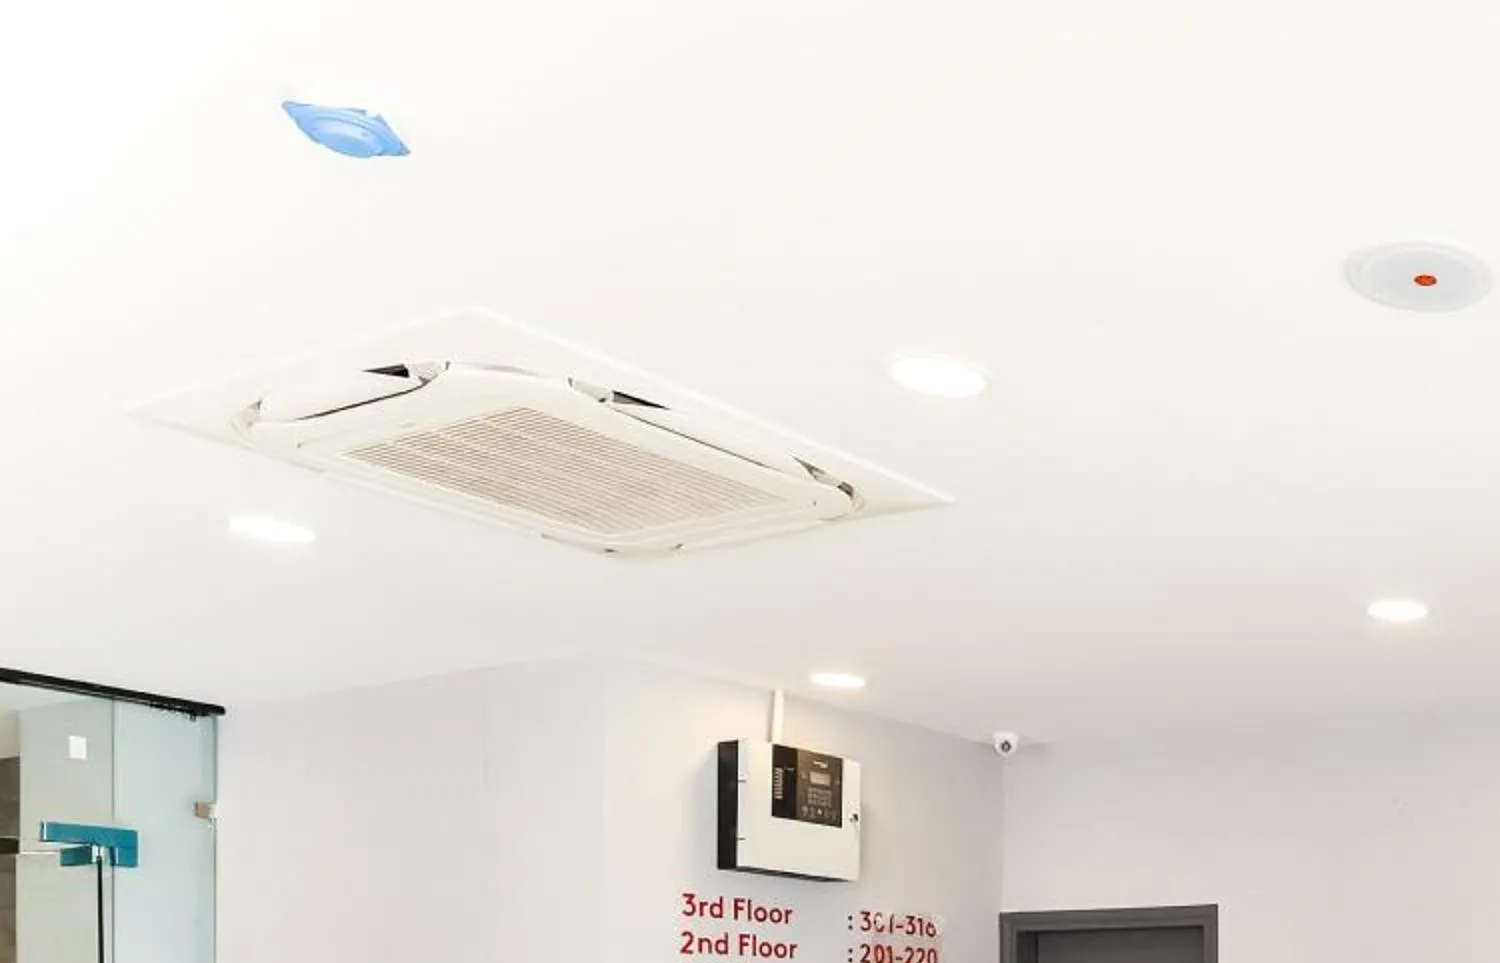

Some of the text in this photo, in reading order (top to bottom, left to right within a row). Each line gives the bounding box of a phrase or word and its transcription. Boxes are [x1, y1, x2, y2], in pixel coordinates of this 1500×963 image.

[681, 893, 724, 919] 3rd
[733, 897, 793, 924] Floor
[680, 931, 729, 955] 2nd
[738, 933, 798, 959] Floor
